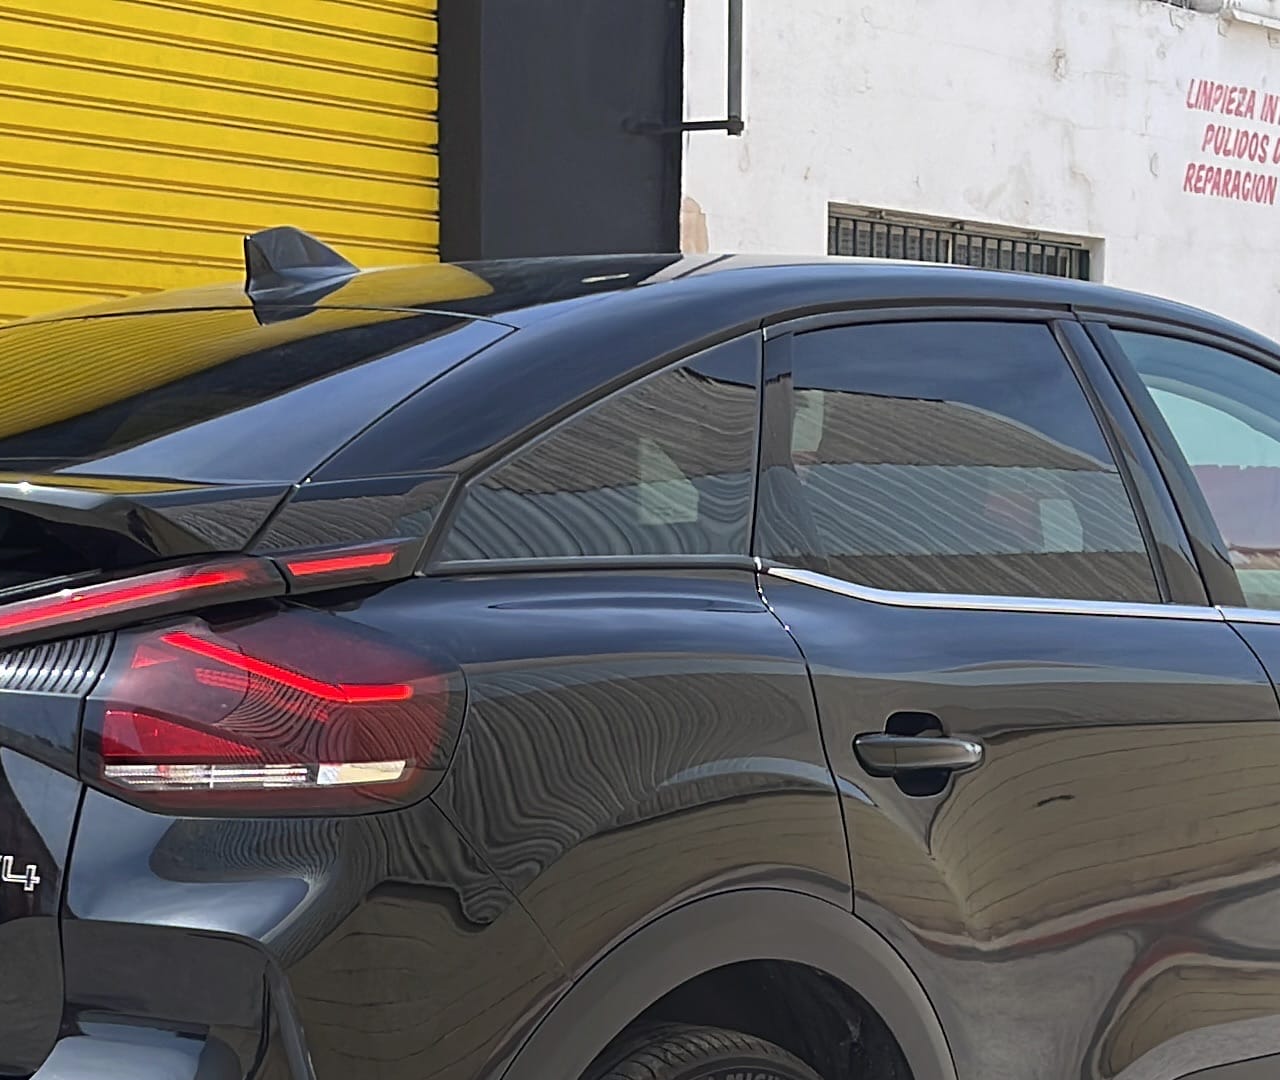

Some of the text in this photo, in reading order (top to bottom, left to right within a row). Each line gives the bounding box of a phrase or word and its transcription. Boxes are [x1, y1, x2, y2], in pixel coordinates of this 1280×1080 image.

[1186, 78, 1256, 119] LIMPIEZA
[1201, 124, 1269, 164] PULIDOS
[1183, 163, 1278, 205] REPARACION
